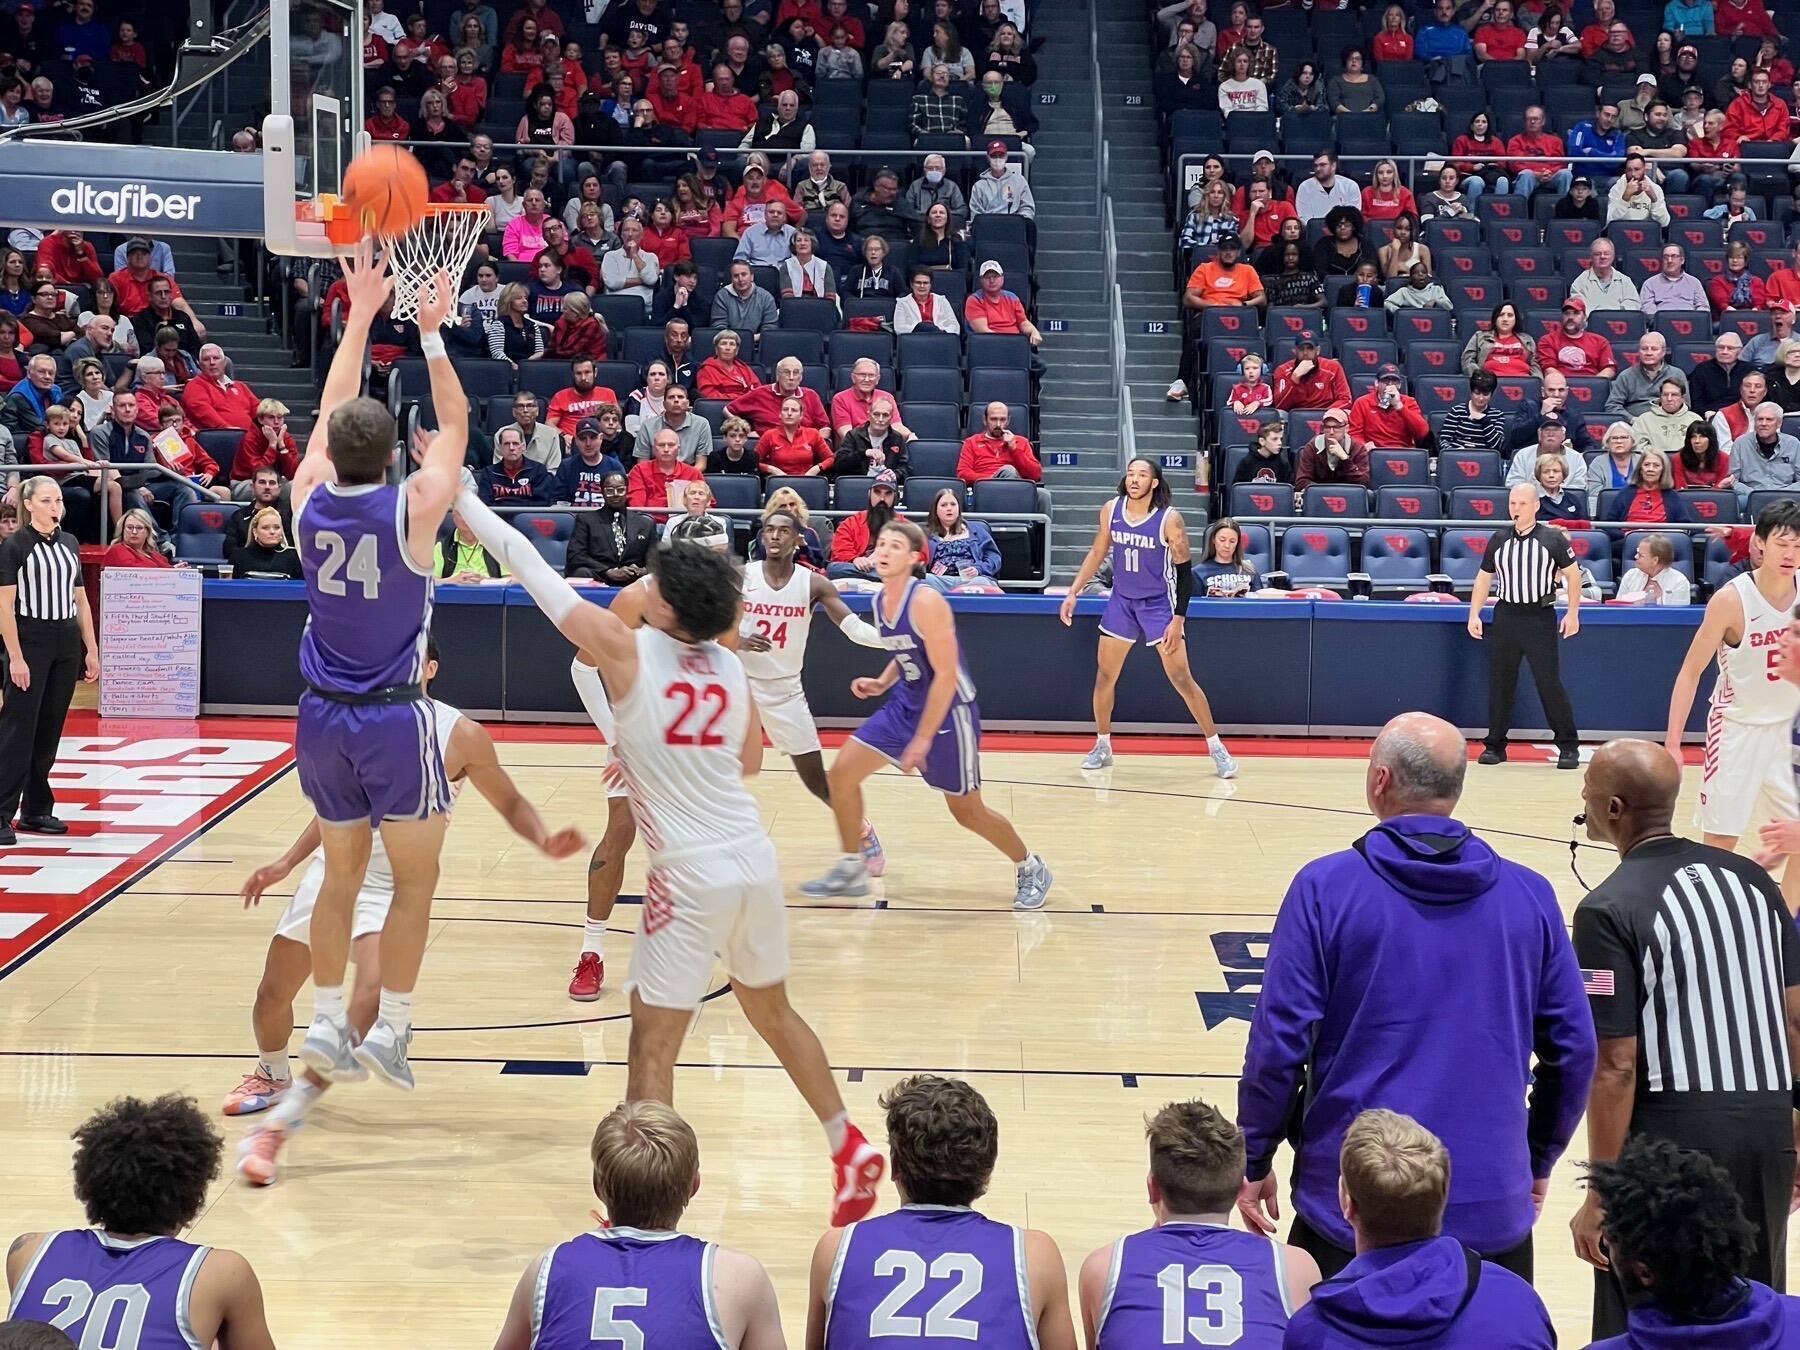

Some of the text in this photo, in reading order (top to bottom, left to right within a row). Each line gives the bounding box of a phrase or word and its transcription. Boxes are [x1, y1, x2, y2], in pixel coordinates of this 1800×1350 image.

[1041, 94, 1056, 104] 217
[1126, 95, 1142, 105] 218
[51, 182, 201, 224] altafiber
[224, 305, 237, 316] 111
[1050, 320, 1062, 331] 111
[1148, 322, 1164, 333] 112
[1057, 453, 1071, 465] 111
[1165, 455, 1183, 467] 112
[579, 471, 601, 483] THIS
[492, 484, 533, 498] DAYTON
[576, 481, 602, 492] IS
[1110, 528, 1156, 550] CAPITAL
[315, 530, 381, 599] 24
[1124, 548, 1139, 573] 11
[743, 600, 806, 618] DAYTON
[756, 619, 788, 649] 24
[664, 682, 730, 746] 22
[869, 1249, 984, 1341] 22
[1156, 1263, 1244, 1346] 13
[42, 1278, 151, 1350] 20
[590, 1287, 647, 1350] 5
